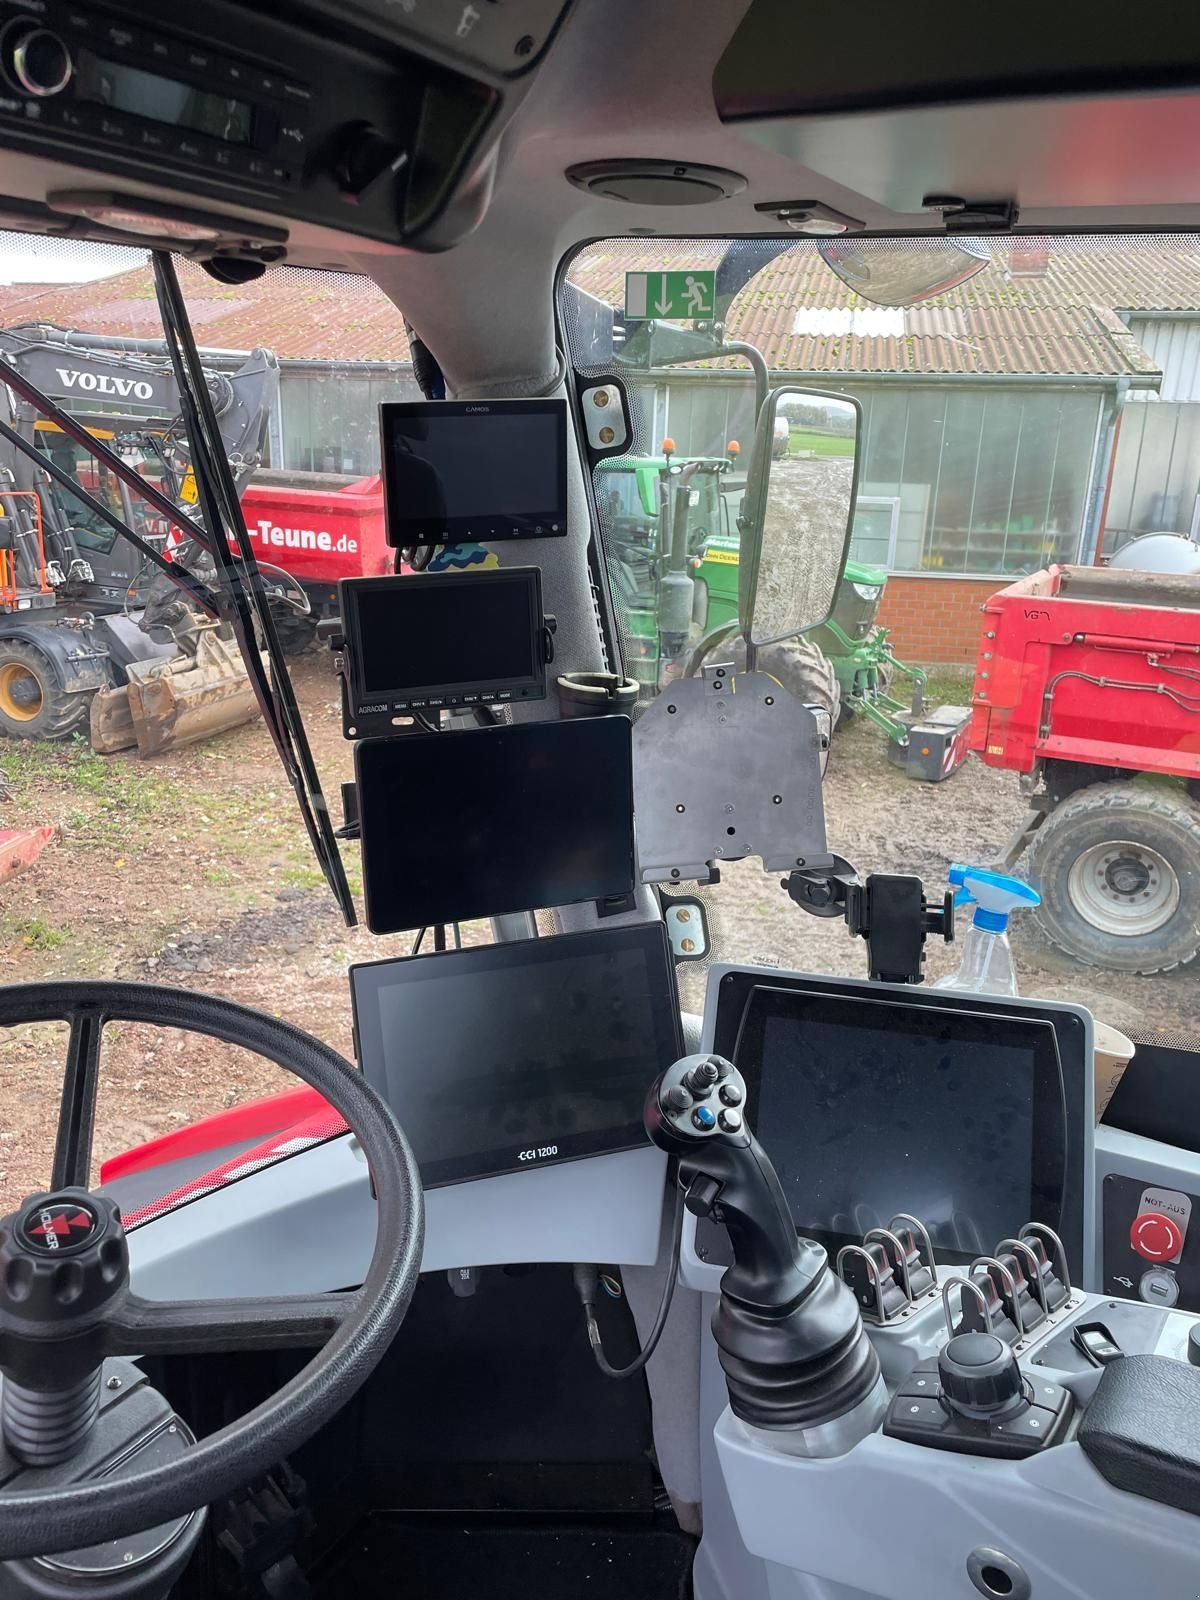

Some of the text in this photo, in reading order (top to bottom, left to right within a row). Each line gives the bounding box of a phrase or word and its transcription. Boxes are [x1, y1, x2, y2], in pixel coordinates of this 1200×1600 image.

[55, 368, 153, 400] VOLVO
[358, 704, 388, 714] AGRACOM
[537, 1145, 558, 1158] 1200
[1144, 1196, 1186, 1215] NOT-AUS
